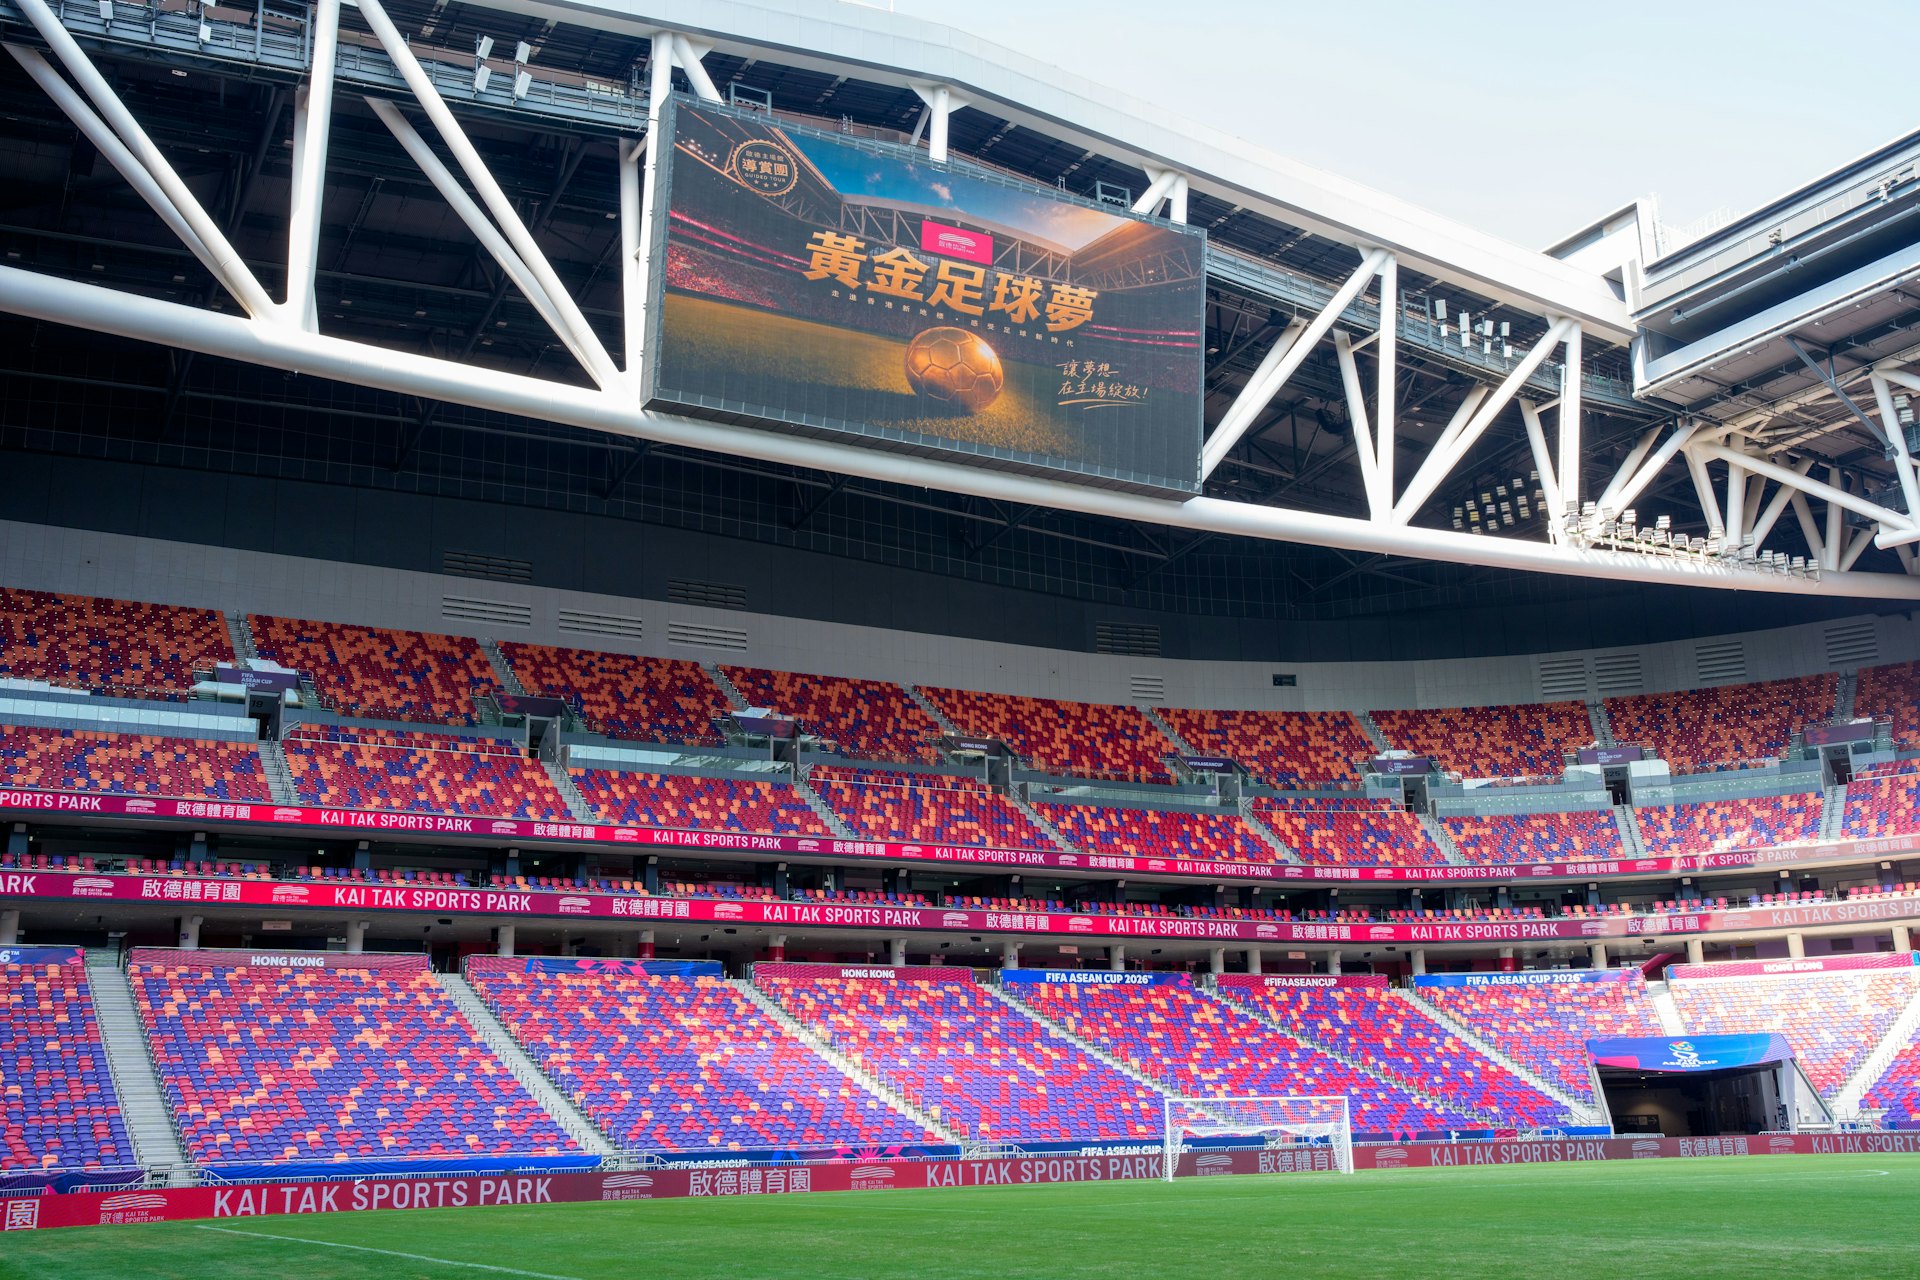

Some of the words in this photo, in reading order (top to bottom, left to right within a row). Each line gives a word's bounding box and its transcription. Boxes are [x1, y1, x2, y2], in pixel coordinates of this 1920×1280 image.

[742, 158, 788, 177] 導賞團
[802, 231, 1098, 332] 黃金足球夢
[1056, 360, 1119, 381] 讓夢想
[59, 796, 101, 810] PARK
[176, 801, 250, 819] 啟德體育園
[321, 811, 345, 825] KAI
[350, 813, 375, 826] TAK
[380, 815, 433, 829] SPORTS
[438, 818, 472, 831] PARK
[533, 823, 595, 839] 啟德體育園
[654, 831, 674, 843] KAI
[678, 832, 700, 844] TAK
[703, 834, 748, 848] SPORTS
[752, 837, 781, 849] PARK
[833, 841, 885, 855] 啟德體育園
[936, 847, 953, 859] KAI
[956, 849, 975, 860] TAK
[978, 850, 1016, 862] SPORTS
[1020, 852, 1045, 864] PARK
[1089, 856, 1135, 869] 啟德體育園
[1671, 856, 1691, 869] KAI
[1693, 854, 1716, 867] TAK
[1719, 852, 1764, 866] SPORTS
[1767, 849, 1798, 862] PARK
[1177, 861, 1192, 872] KAI
[1195, 862, 1211, 873] TAK
[1214, 863, 1247, 875] SPORTS
[1250, 865, 1272, 876] PARK
[1405, 869, 1422, 879] KAI
[1425, 868, 1444, 879] TAK
[1447, 867, 1486, 878] SPORTS
[1489, 866, 1517, 877] PARK
[142, 880, 241, 900] 啟德體育園
[334, 888, 365, 905] KAI
[371, 889, 406, 906] TAK
[412, 891, 480, 909] SPORTS
[487, 894, 531, 911] PARK
[612, 898, 690, 917] 啟德體育園
[763, 905, 788, 921] KAI
[792, 907, 820, 922] TAK
[825, 908, 879, 924] SPORTS
[884, 910, 921, 925] PARK
[986, 913, 1049, 930] 啟德體育園
[1772, 908, 1805, 925] KAI
[1807, 905, 1831, 922] TAK
[1837, 902, 1899, 920] SPORTS
[1109, 919, 1129, 932] KAI
[1133, 919, 1156, 933] TAK
[1159, 921, 1205, 935] SPORTS
[1208, 923, 1238, 936] PARK
[1292, 925, 1351, 939] 啟德體育園
[1411, 926, 1432, 939] KAI
[1436, 925, 1462, 939] TAK
[1465, 924, 1518, 938] SPORTS
[1523, 922, 1559, 936] PARK
[1627, 916, 1699, 933] 啟德體育園
[251, 956, 287, 966] HONG
[290, 957, 324, 967] KONG
[1763, 963, 1793, 972] HONG
[1794, 962, 1823, 971] KONG
[841, 969, 868, 978] HONG
[869, 970, 895, 978] KONG
[1046, 972, 1068, 982] FIFA
[1069, 973, 1102, 983] ASEAN
[1104, 974, 1123, 983] CUP
[1466, 976, 1489, 985] FIFA
[1491, 975, 1527, 985] ASEAN
[1529, 974, 1550, 984] CUP
[1264, 978, 1337, 987] #FIFAASEANCUP
[1081, 1147, 1103, 1156] FIFA
[1104, 1146, 1140, 1155] ASEAN
[1141, 1145, 1161, 1154] CUP
[1812, 1137, 1834, 1153] KAI
[1837, 1135, 1863, 1153] TAK
[1431, 1147, 1458, 1166] KAI
[1464, 1145, 1495, 1164] TAK
[1501, 1143, 1561, 1163] SPORTS
[1566, 1141, 1606, 1160] PARK
[668, 1159, 748, 1169] #FIFAASEANCUP
[926, 1164, 962, 1187] KAI
[971, 1161, 1013, 1185] TAK
[1020, 1159, 1101, 1183] SPORTS
[1109, 1157, 1161, 1179] PARK
[688, 1168, 811, 1196] 啟德體育園
[213, 1187, 267, 1217] KAI
[280, 1185, 340, 1213] TAK
[352, 1180, 468, 1210] SPORTS
[479, 1178, 552, 1205] PARK
[0, 1199, 40, 1231] 園
